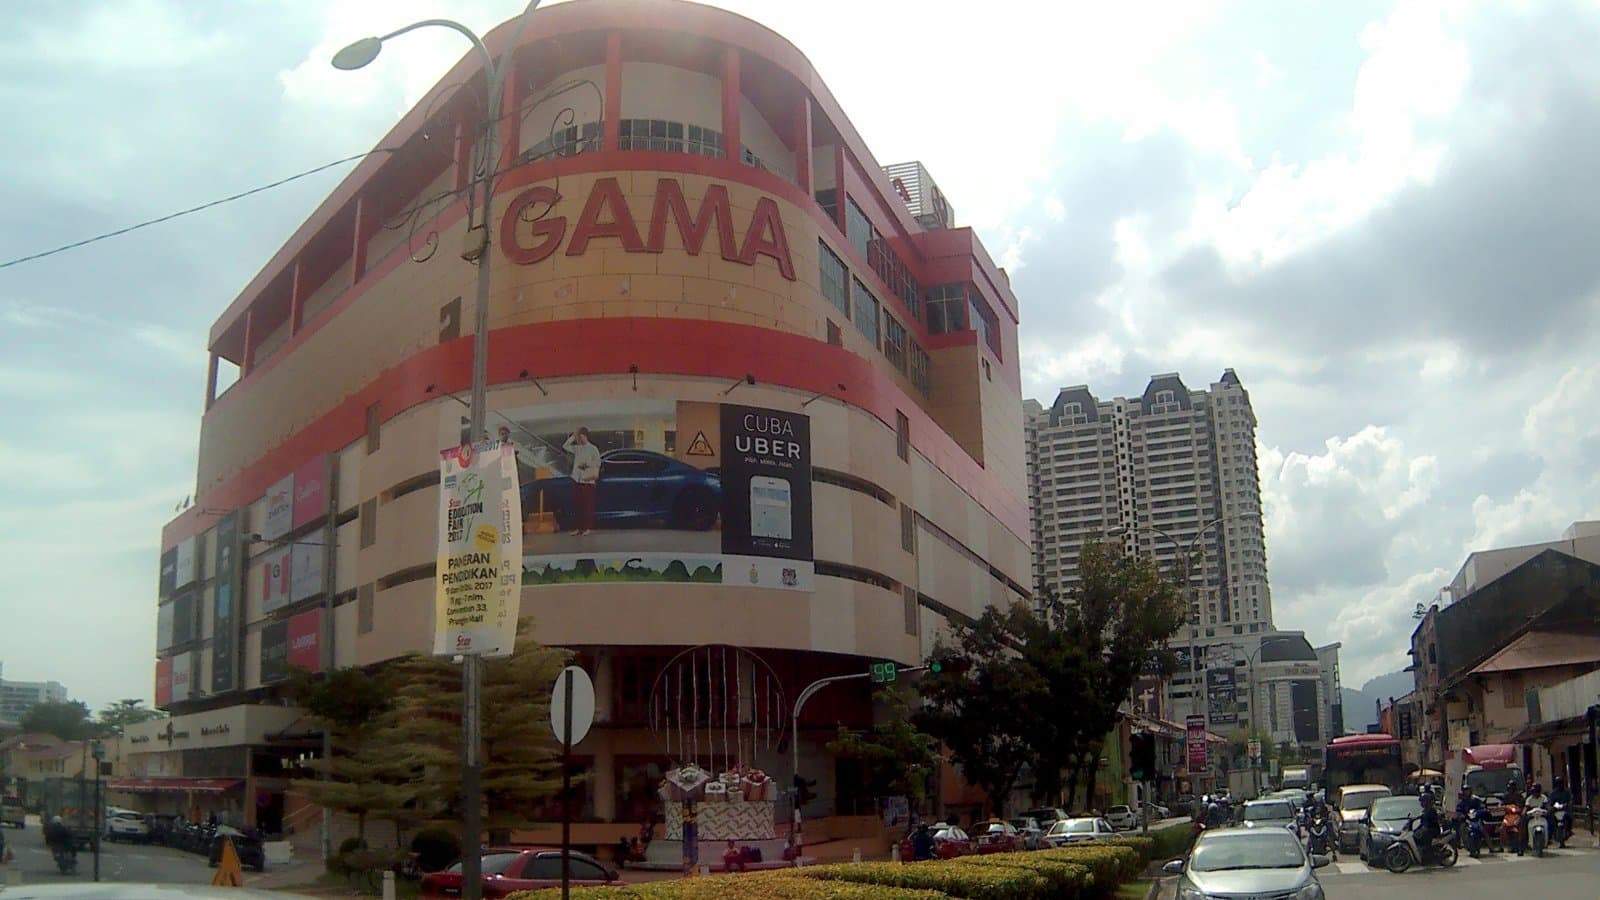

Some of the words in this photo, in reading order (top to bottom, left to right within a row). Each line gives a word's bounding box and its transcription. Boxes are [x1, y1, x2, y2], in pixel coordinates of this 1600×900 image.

[500, 177, 797, 282] GAMA
[743, 414, 794, 437] CUBA
[735, 435, 801, 459] UBER
[873, 663, 896, 683] 99
